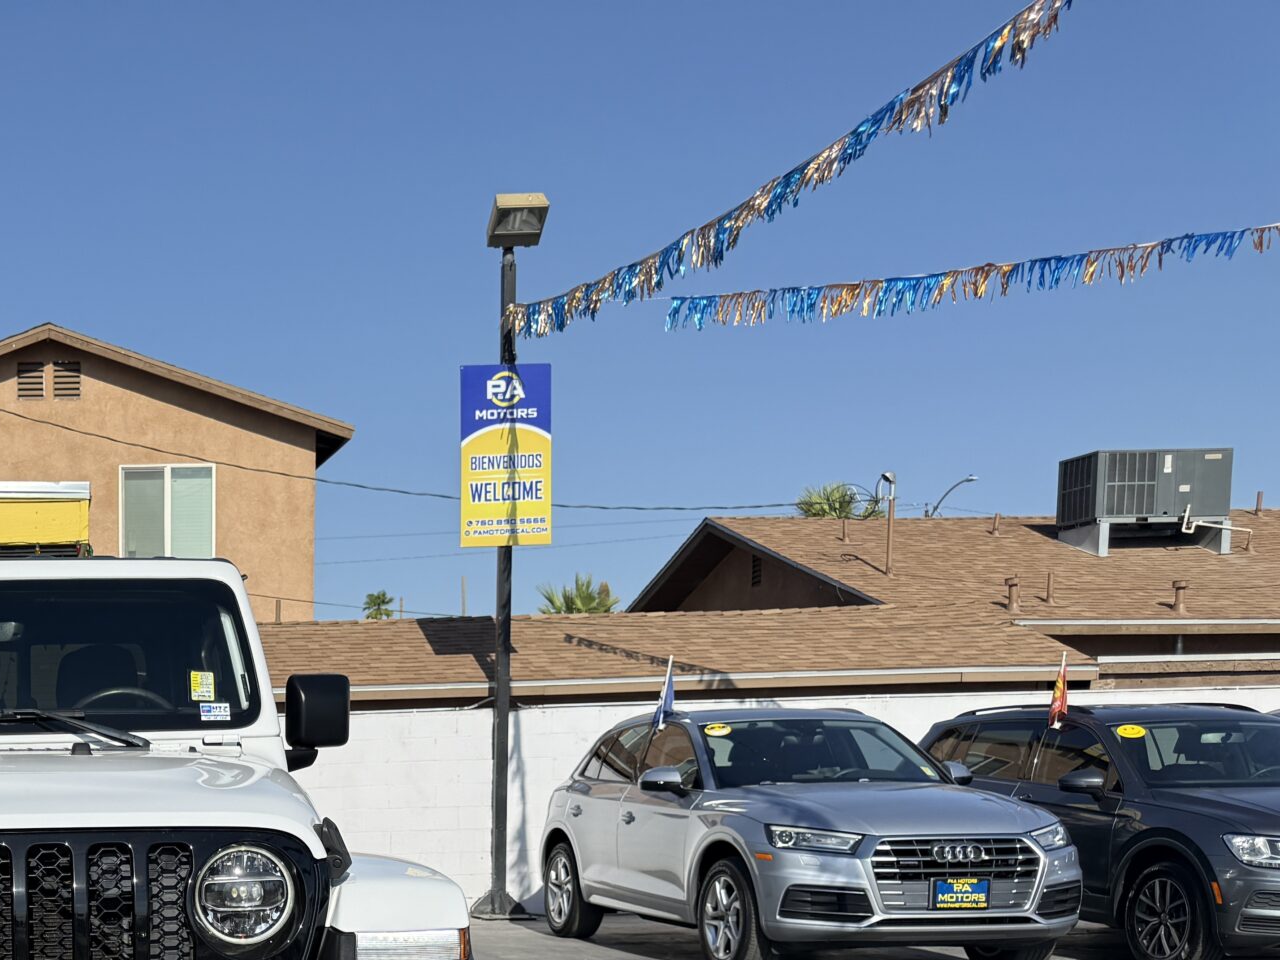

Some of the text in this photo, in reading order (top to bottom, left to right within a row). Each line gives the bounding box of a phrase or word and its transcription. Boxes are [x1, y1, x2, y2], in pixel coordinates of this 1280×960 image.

[475, 408, 538, 421] MOTORS
[470, 454, 542, 471] BIENVENIDOS
[470, 481, 543, 502] WELCOME
[938, 893, 986, 901] MOTORS
